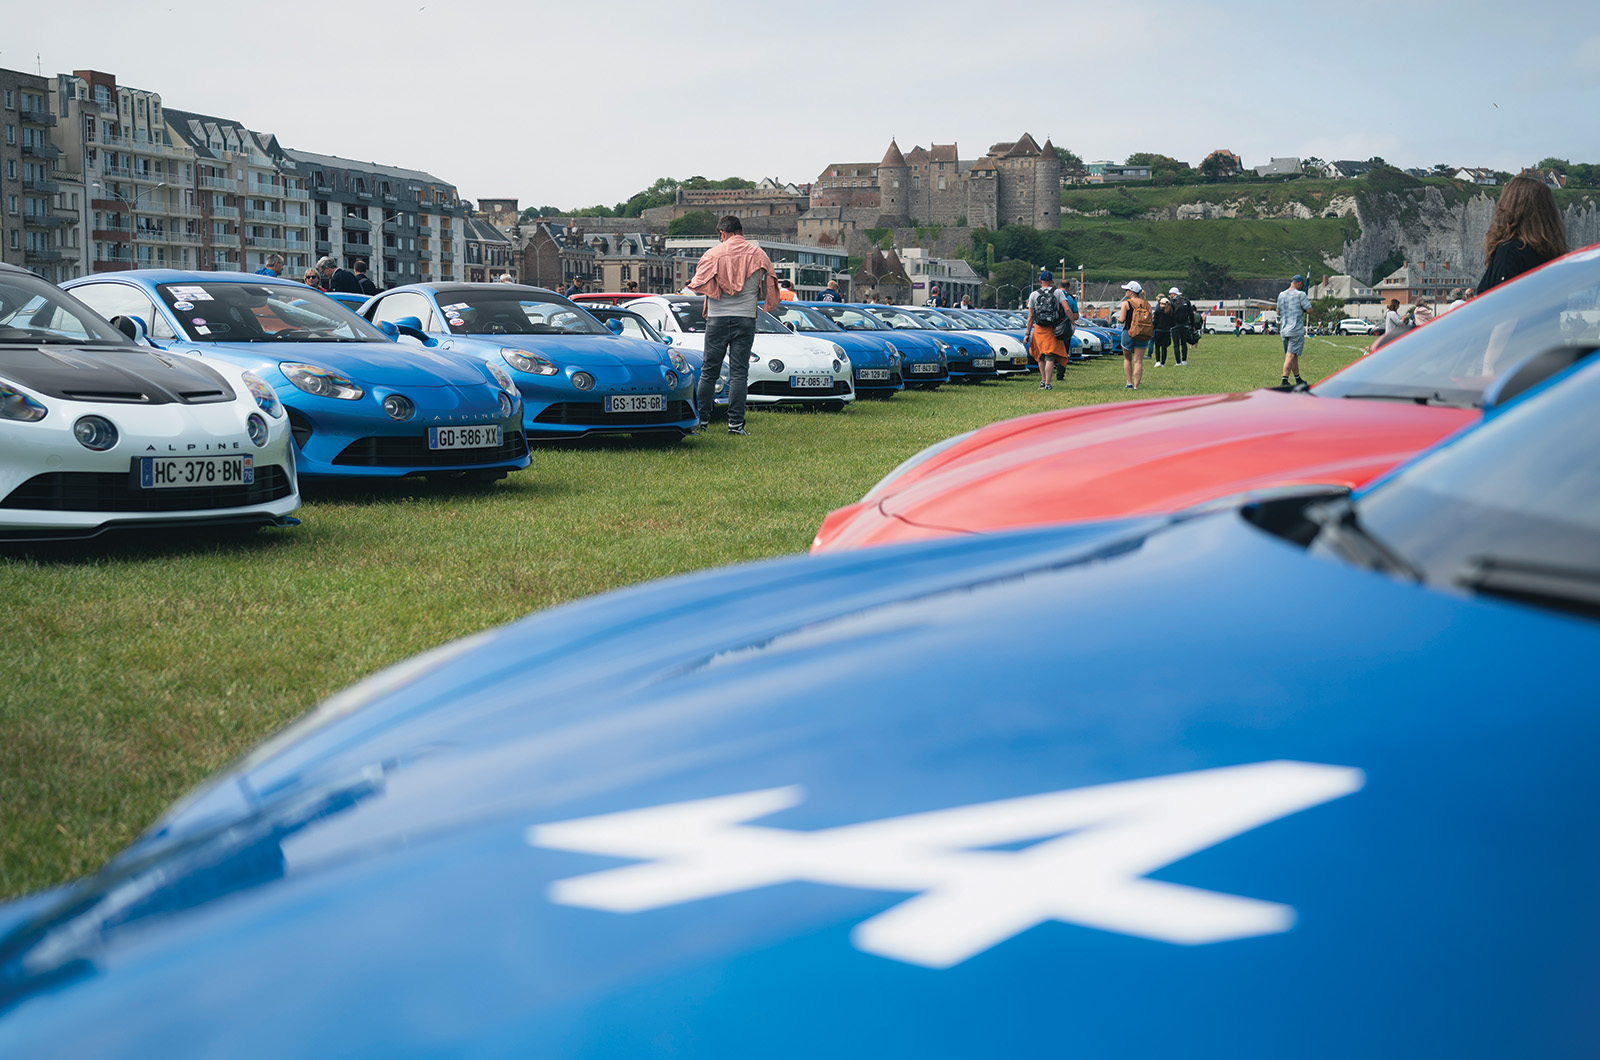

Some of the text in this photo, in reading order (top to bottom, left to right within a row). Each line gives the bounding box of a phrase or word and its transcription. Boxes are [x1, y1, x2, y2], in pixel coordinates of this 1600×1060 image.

[613, 397, 661, 410] GS-135-GR
[439, 428, 497, 446] GD-586-XX
[146, 442, 240, 451] ALPINE
[155, 460, 242, 484] HC-378-BN
